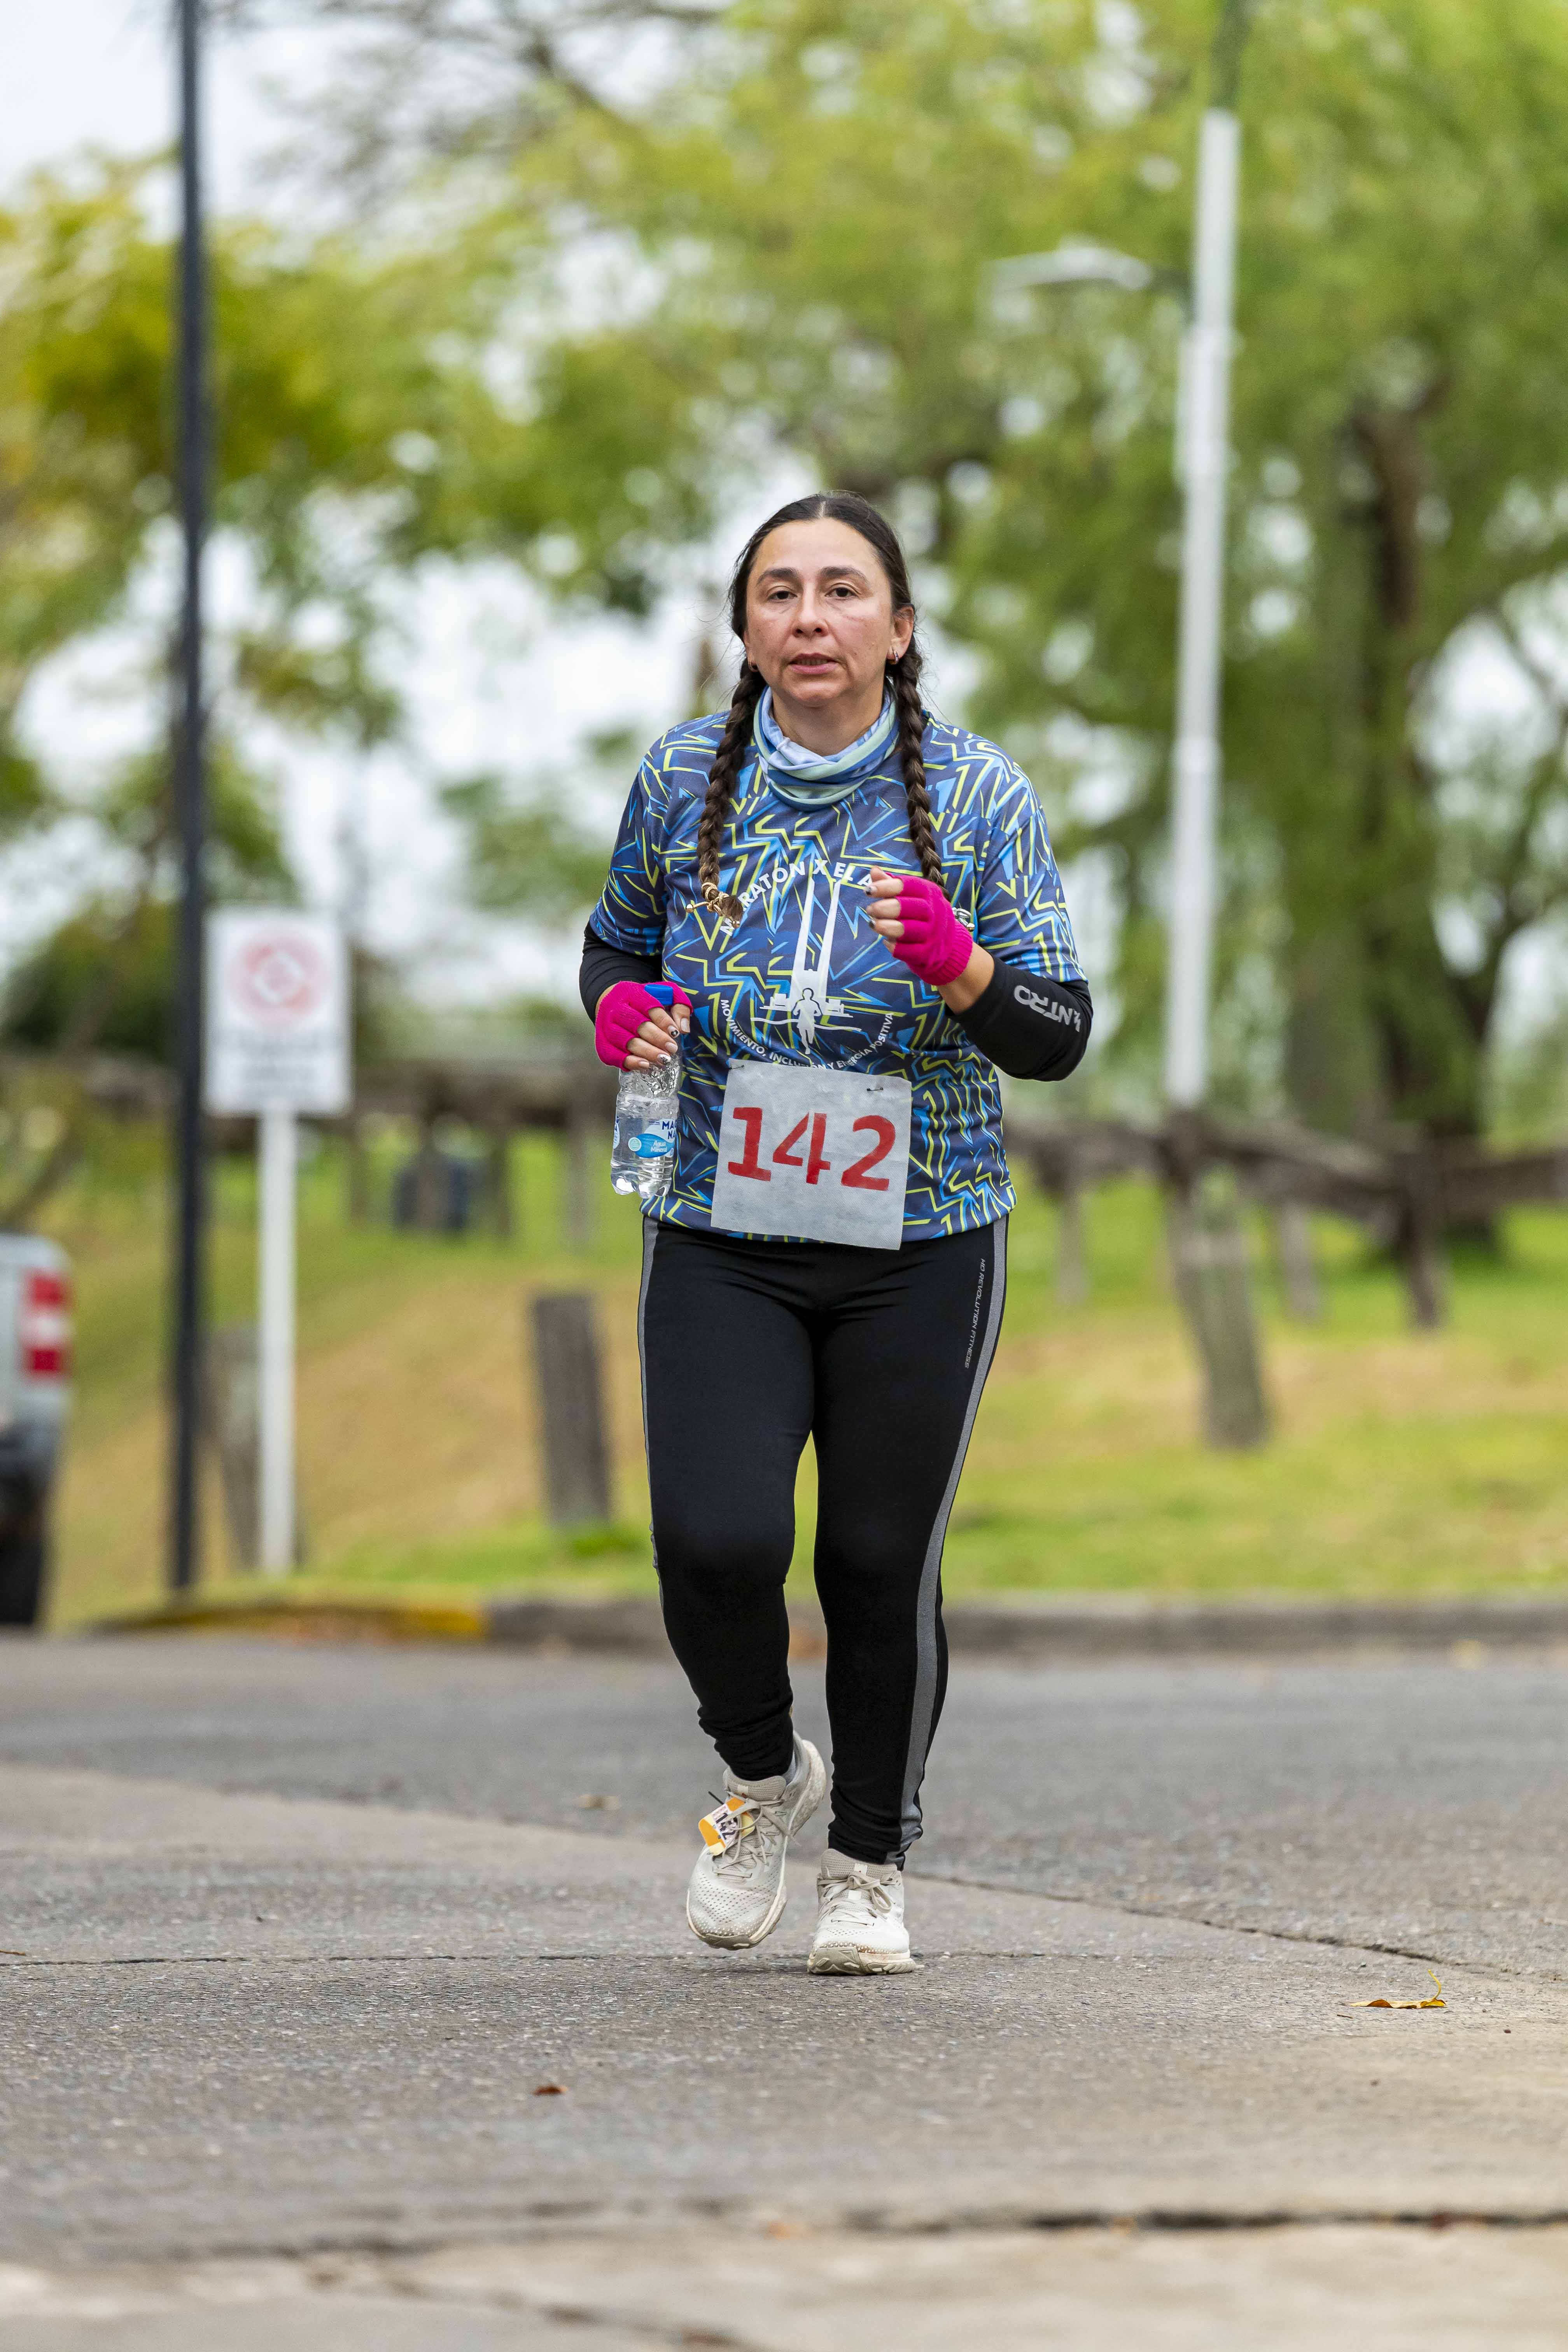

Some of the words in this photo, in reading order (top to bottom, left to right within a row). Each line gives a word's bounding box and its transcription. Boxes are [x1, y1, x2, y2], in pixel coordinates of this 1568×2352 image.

[719, 861, 806, 936] MRATON
[812, 859, 828, 875] X
[833, 862, 854, 882] EL
[721, 999, 766, 1057] MOVIMIENTO,
[836, 1048, 872, 1068] ENERGÍA
[870, 1013, 893, 1050] POSITIVA
[653, 1140, 666, 1148] Agua
[727, 1107, 896, 1192] 142
[972, 1272, 984, 1329] REVOLUTION
[964, 1330, 976, 1369] FITNESS
[716, 1812, 736, 1841] 142
